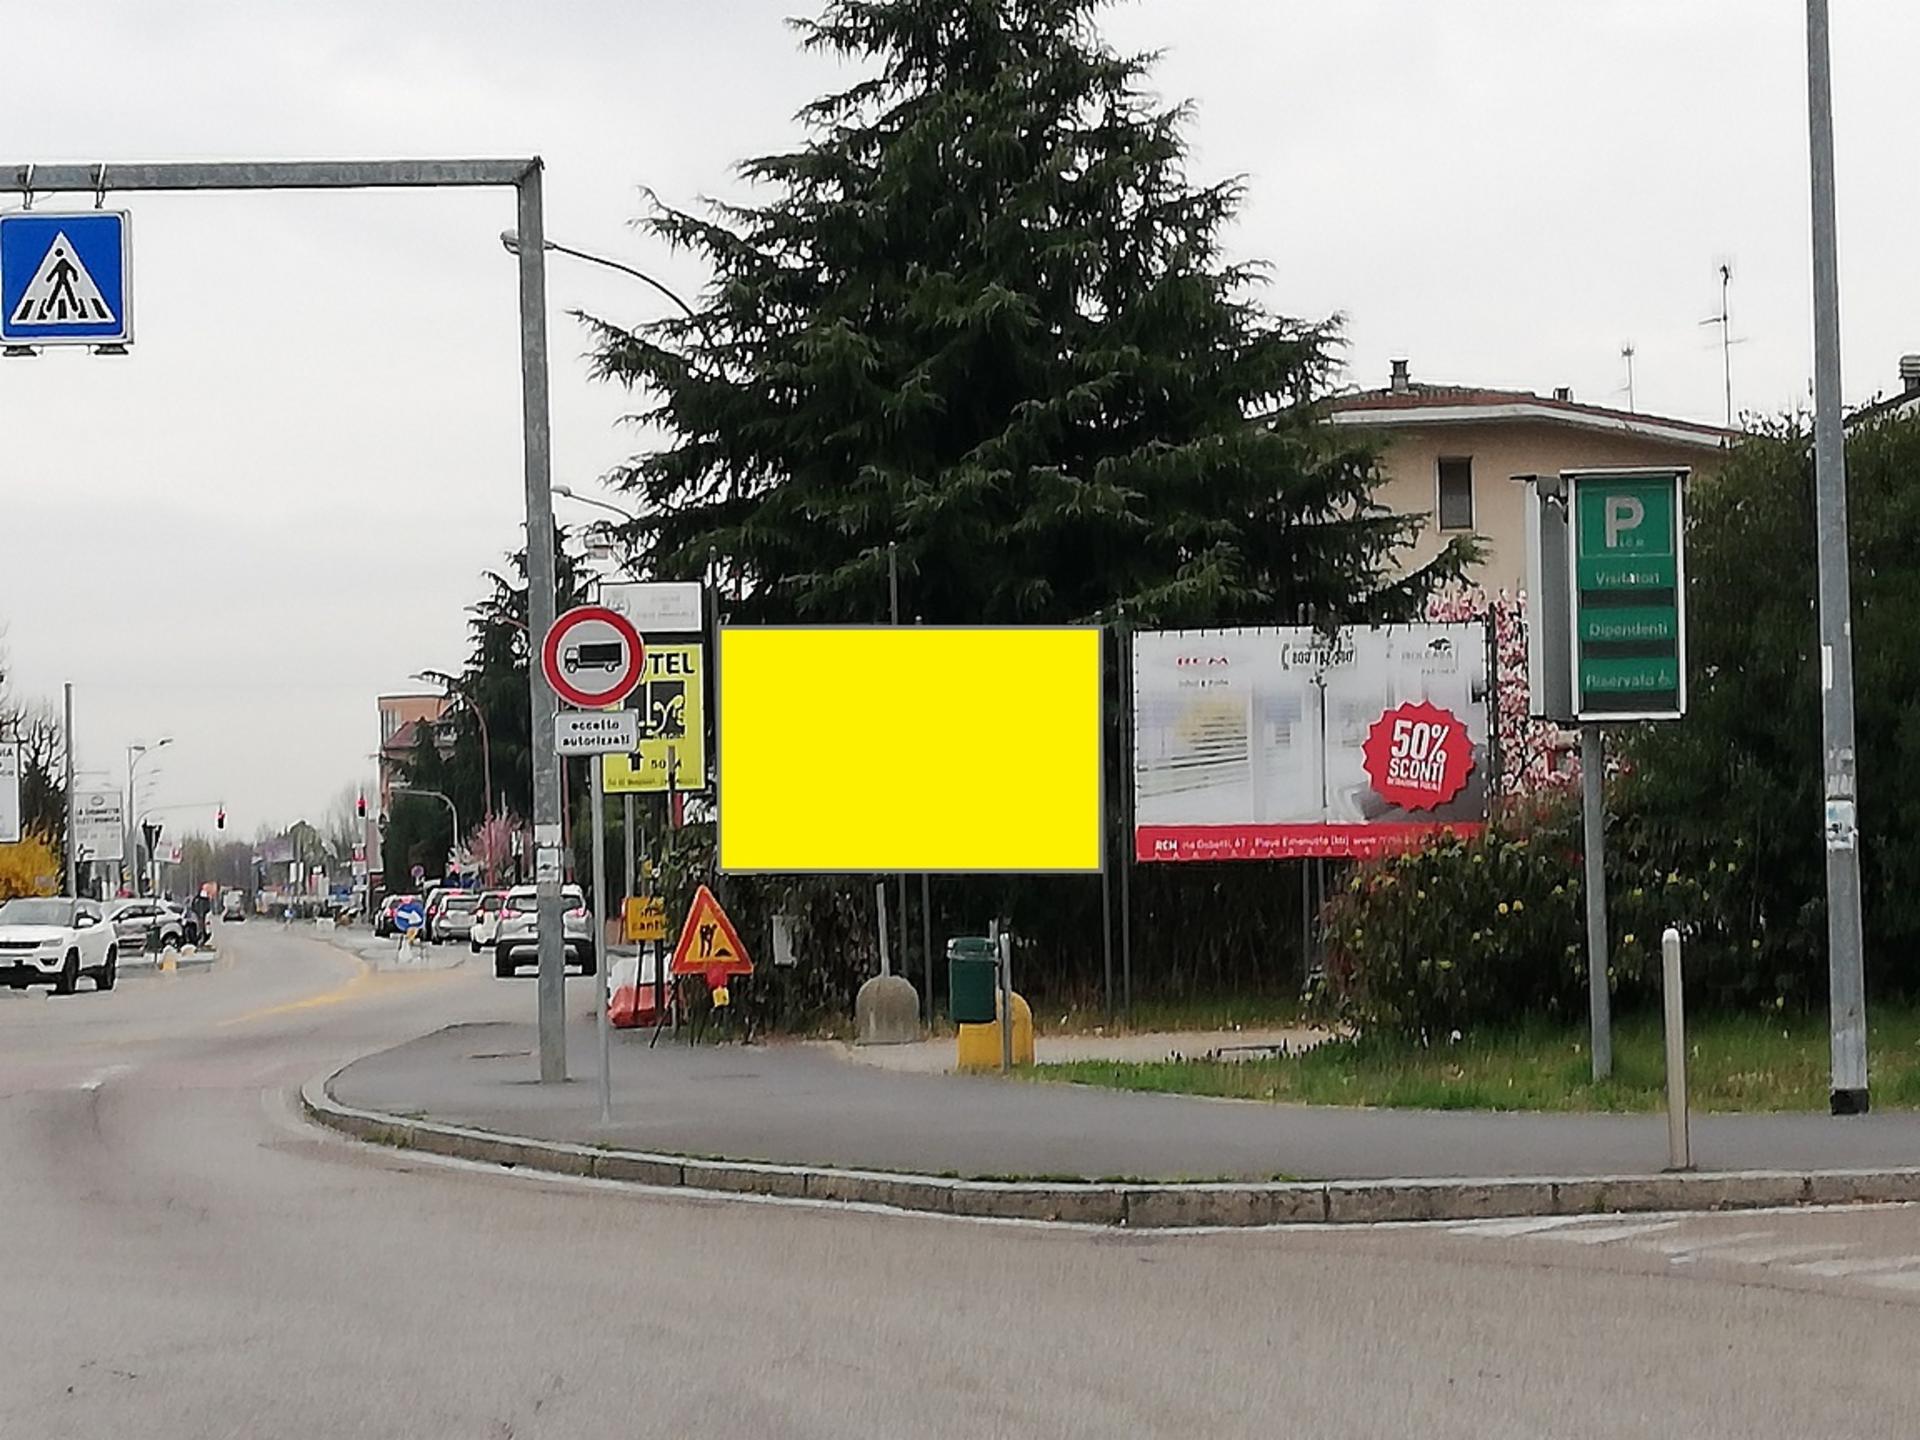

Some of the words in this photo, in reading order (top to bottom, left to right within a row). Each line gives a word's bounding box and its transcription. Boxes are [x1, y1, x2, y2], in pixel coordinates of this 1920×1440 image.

[1606, 496, 1644, 547] P
[1595, 572, 1660, 585] Visitatori
[1589, 622, 1668, 637] Dipendenti
[645, 653, 695, 674] TEL
[1586, 673, 1654, 688] Riservato
[562, 734, 630, 747] autorizzati
[1391, 719, 1449, 763] 50%
[1388, 758, 1444, 783] SCONTI
